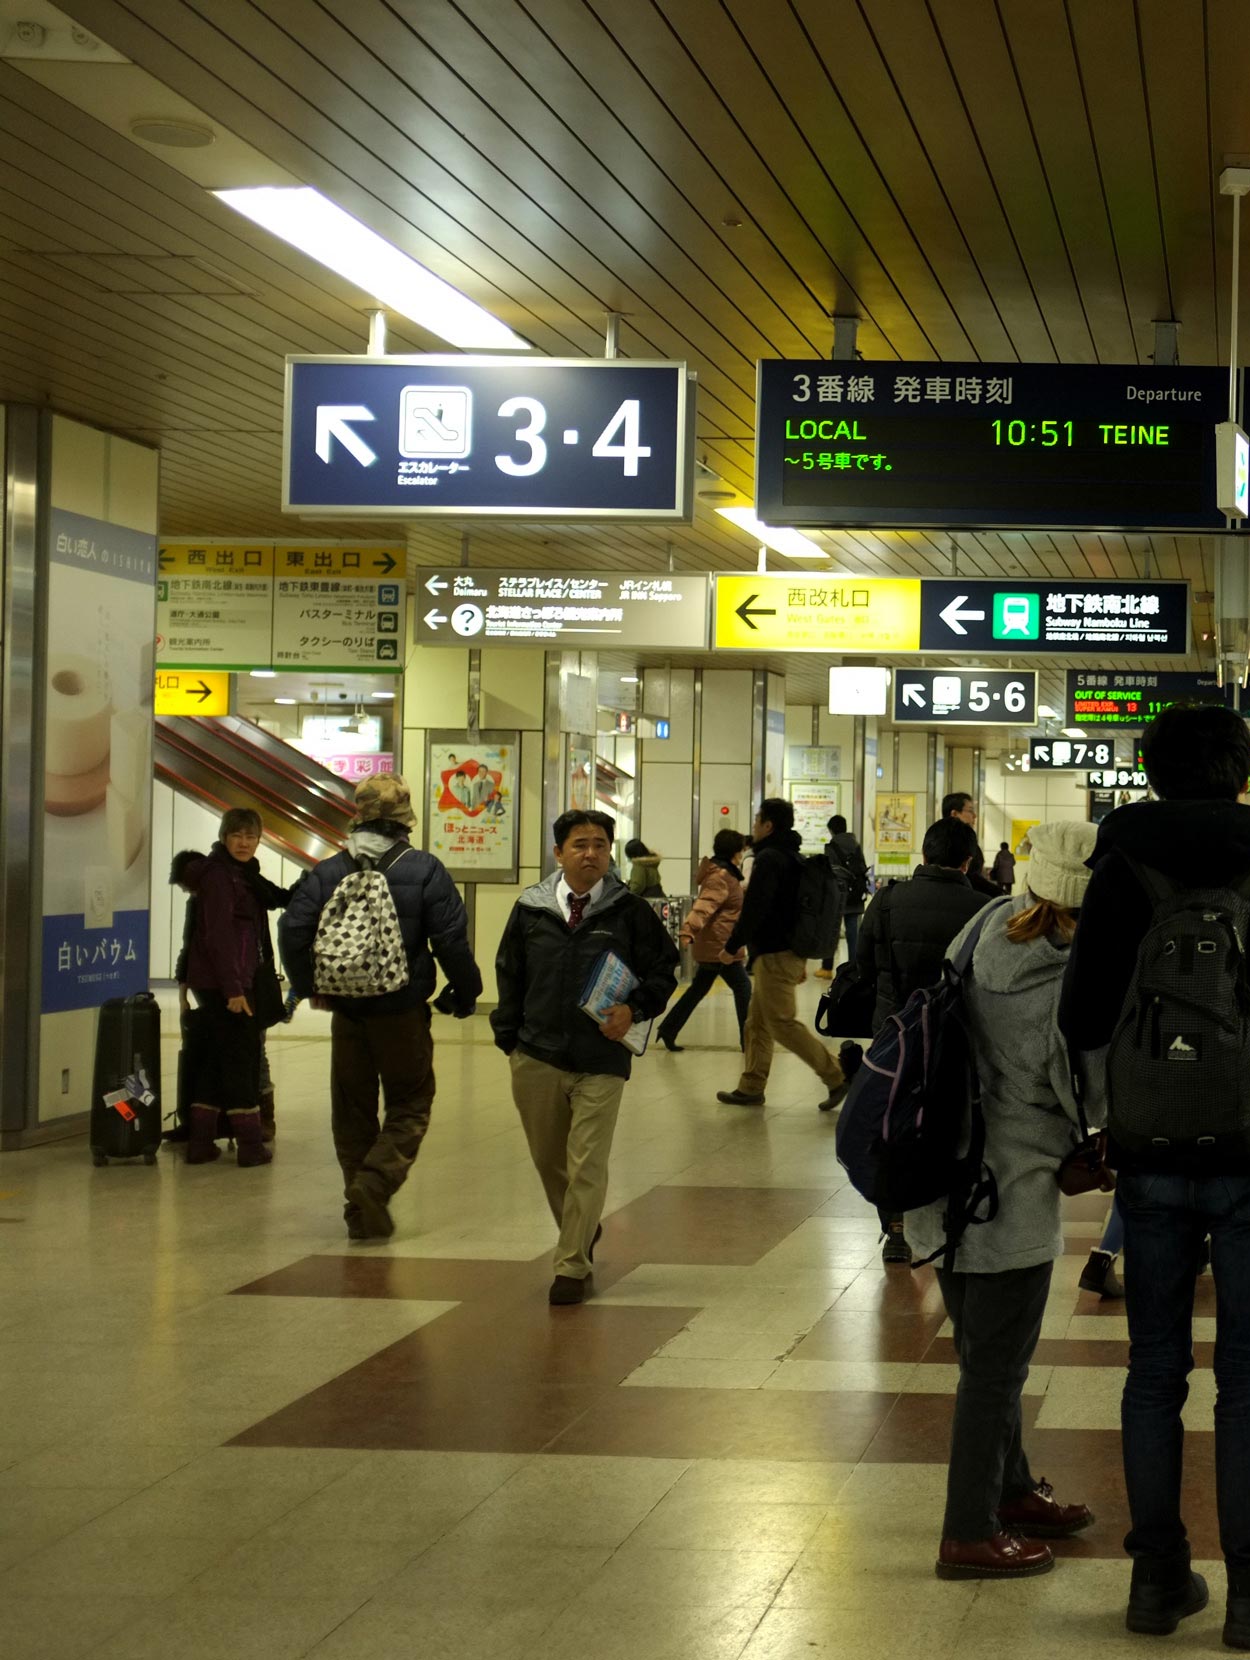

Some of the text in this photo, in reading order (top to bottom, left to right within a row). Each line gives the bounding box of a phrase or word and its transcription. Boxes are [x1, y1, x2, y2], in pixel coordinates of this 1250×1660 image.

[793, 374, 1013, 405] 3番線 発車時刻
[1127, 386, 1202, 402] Departure
[785, 420, 1169, 447] LOCAL 10:51 TEINE
[398, 462, 469, 474] エスカレーター
[397, 474, 438, 485] Escalator
[188, 550, 262, 566] 西出口
[286, 551, 360, 568] 東出口
[498, 588, 534, 598] STELLAR
[788, 588, 869, 607] 西改札口
[1046, 593, 1160, 615] 地下鉄南北線
[299, 609, 376, 620] バスターミナル
[1046, 616, 1150, 629] Subway Namboku Line
[300, 636, 375, 648] タクシーのりば
[1114, 676, 1158, 687] 発車時刻
[1075, 691, 1142, 700] OUT OF SERVICE
[1127, 702, 1137, 712] 13
[58, 938, 136, 972] 白いバウム
